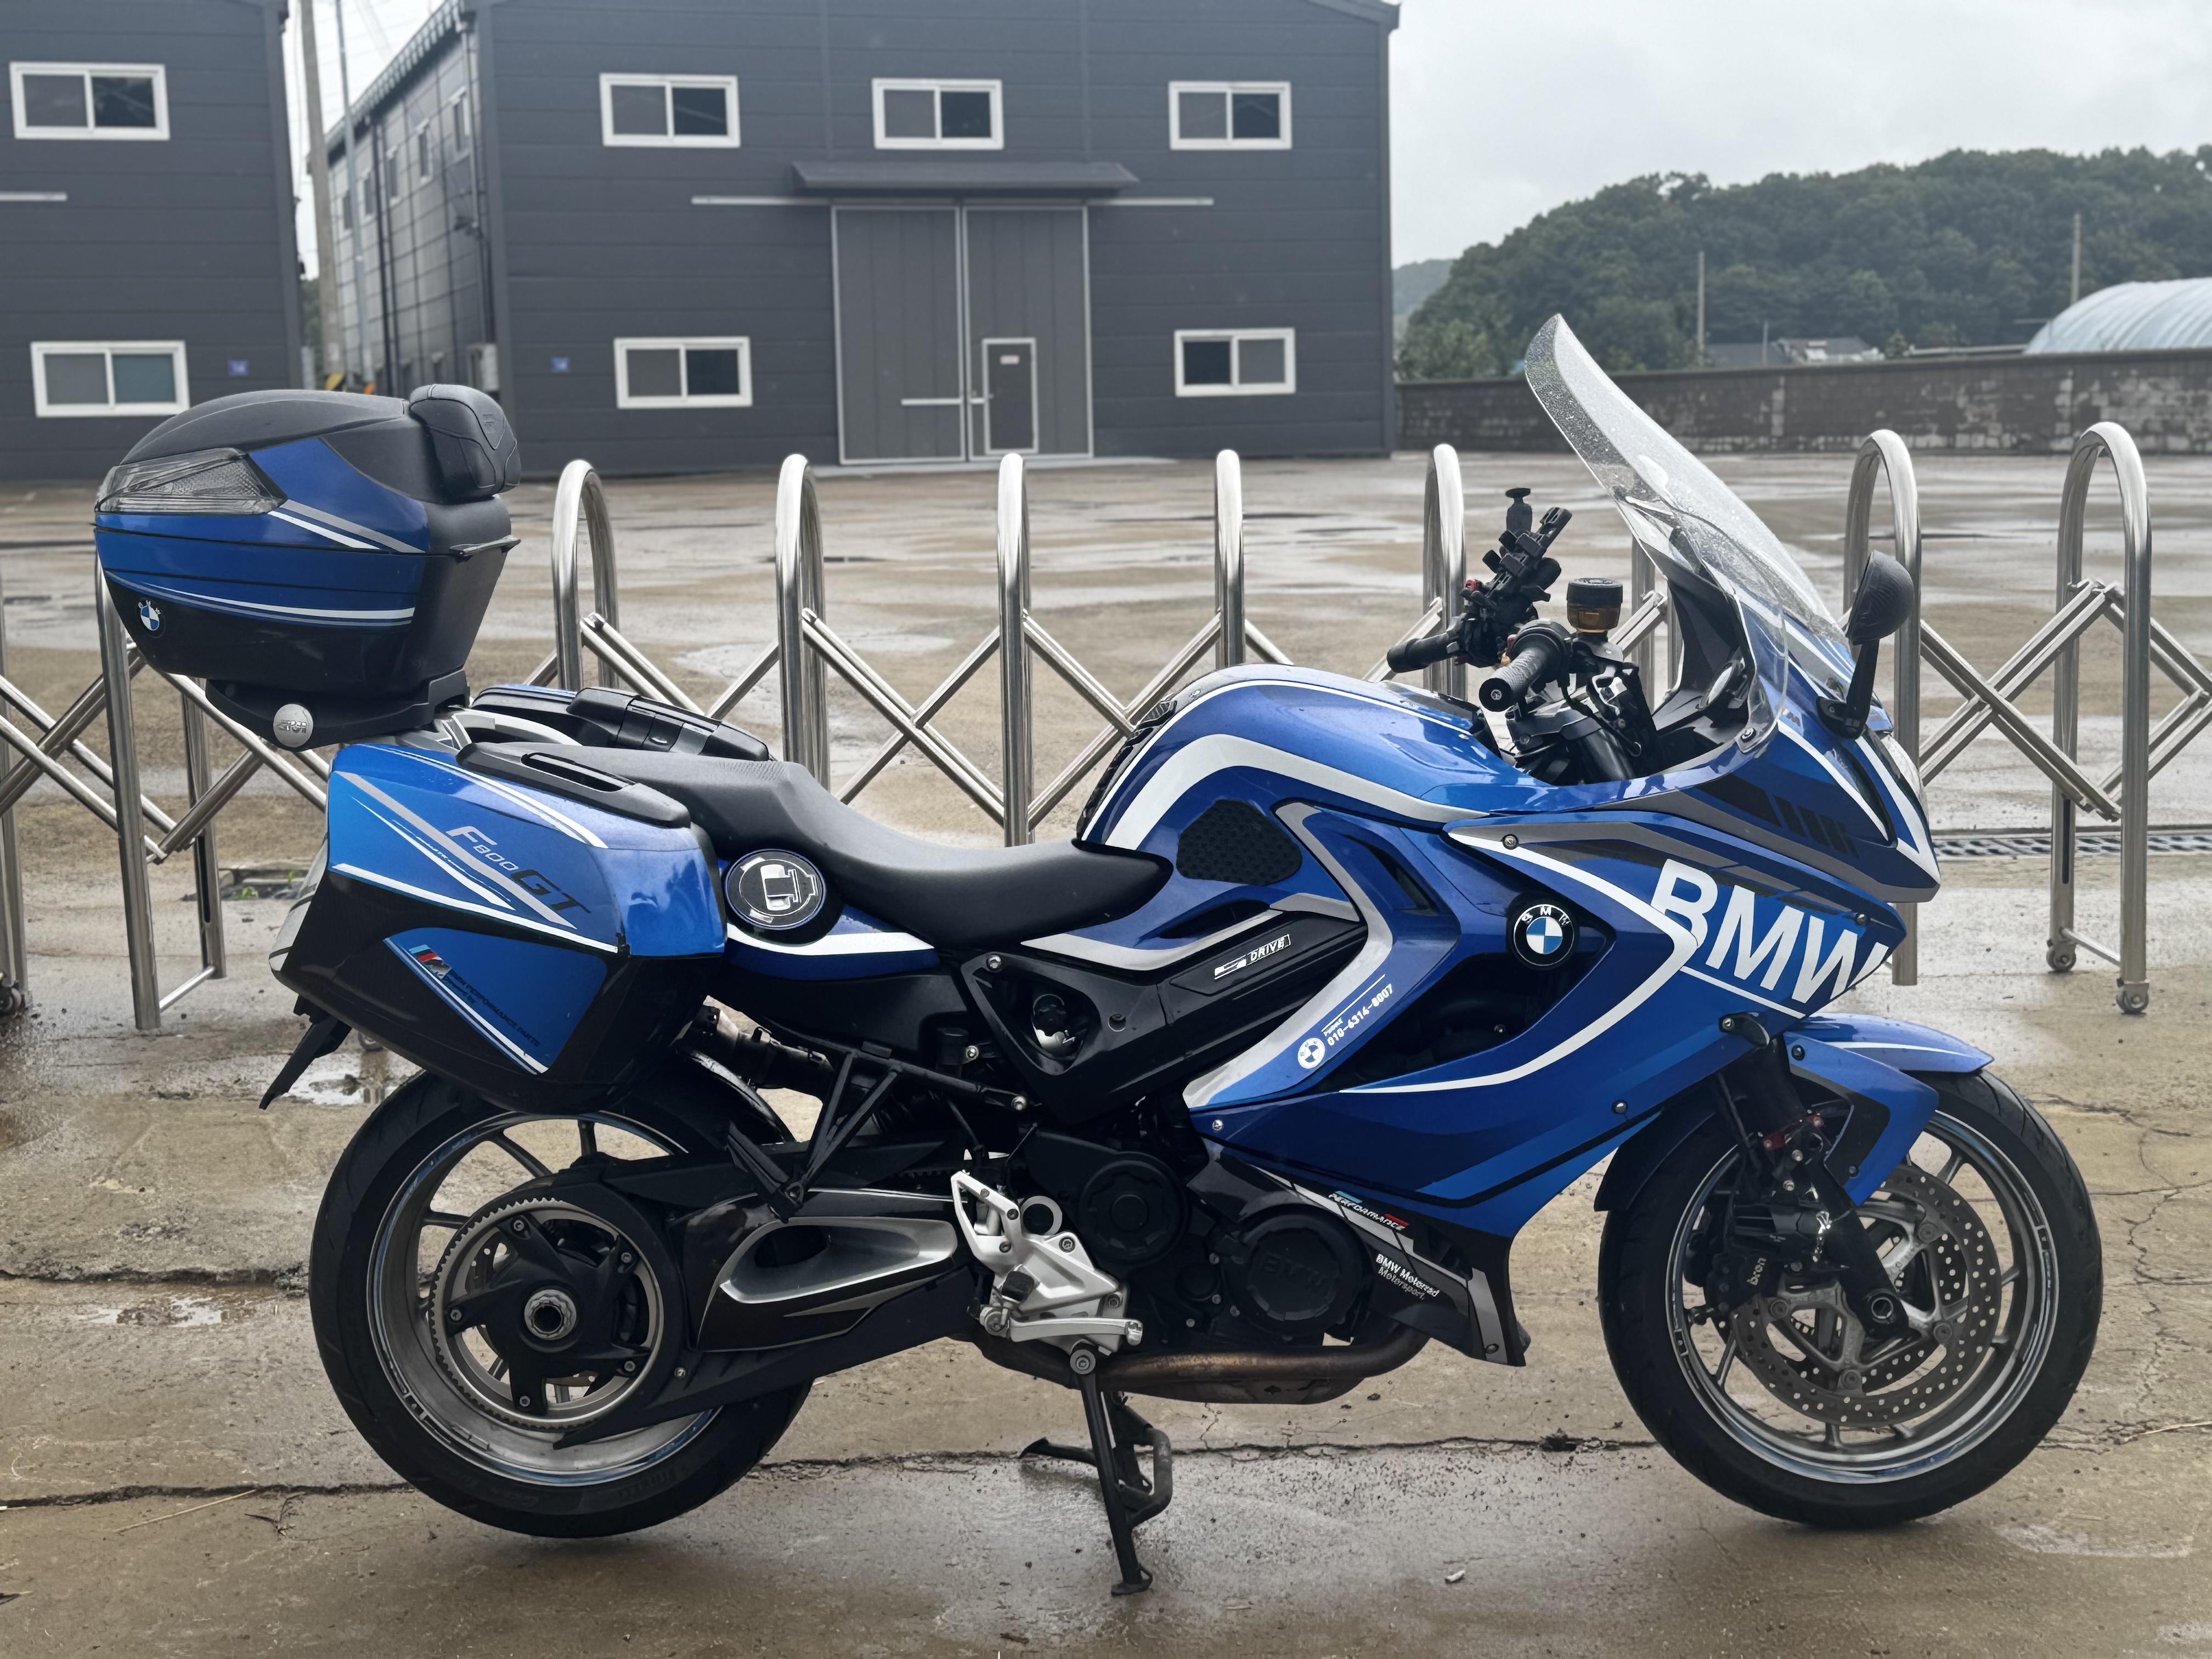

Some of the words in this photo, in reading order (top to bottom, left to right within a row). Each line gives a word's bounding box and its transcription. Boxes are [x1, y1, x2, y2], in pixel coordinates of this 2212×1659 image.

[1250, 936, 1285, 962] DRIVE
[1651, 859, 1889, 1003] BMW
[1376, 1253, 1401, 1273] BMW
[1400, 1268, 1440, 1297] Motorrad
